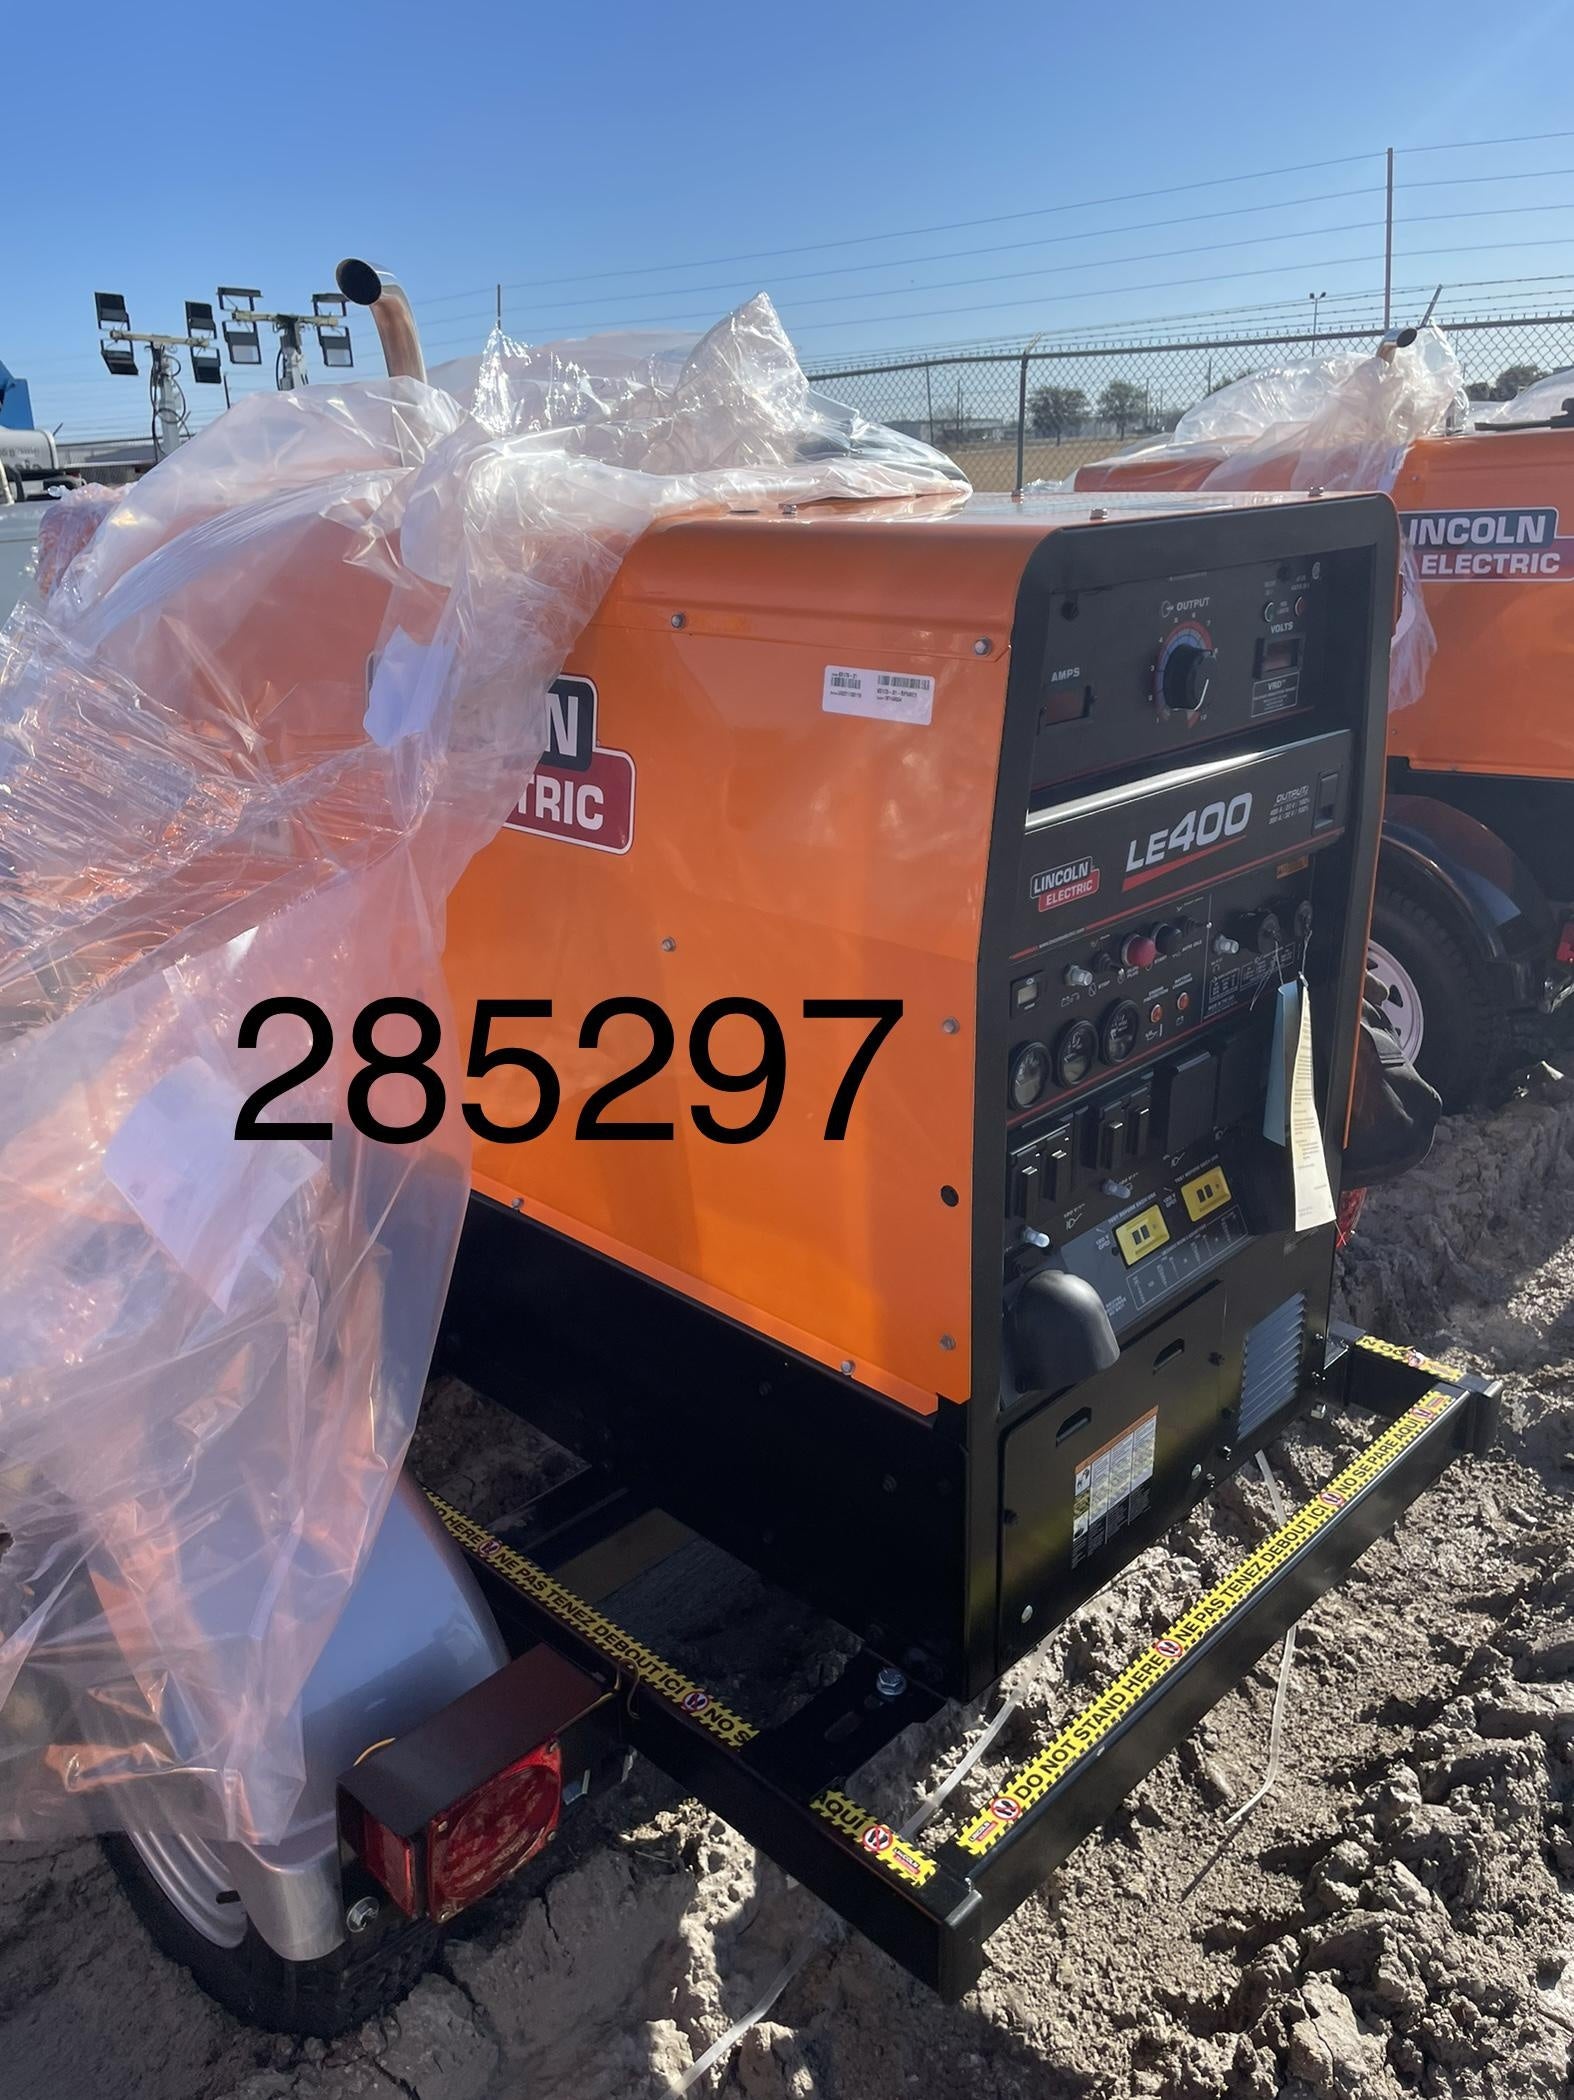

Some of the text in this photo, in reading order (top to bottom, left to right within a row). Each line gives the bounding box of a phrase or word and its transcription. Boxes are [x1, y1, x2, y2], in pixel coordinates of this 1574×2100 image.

[1408, 516, 1546, 545] INCOLN
[1421, 553, 1560, 575] ELECTRIC
[1176, 597, 1210, 611] OUTPUT
[1270, 621, 1294, 634] VOLTS
[1050, 667, 1080, 682] AMPS
[1125, 792, 1253, 872] LE400
[1034, 861, 1089, 893] LINCOLN
[1046, 879, 1093, 906] ELECTRIC
[1336, 1477, 1358, 1493] NO
[1353, 1463, 1373, 1478] SE
[1367, 1440, 1399, 1465] PARE
[444, 1516, 485, 1545] HERE
[1175, 1504, 1329, 1642] NE PAS TENEZ DEBOUT ICI
[495, 1553, 686, 1695] NE PAS TENEZ DEBOUT ICI
[704, 1708, 735, 1732] NO
[1013, 1654, 1165, 1800] DO NOT STAND HERE
